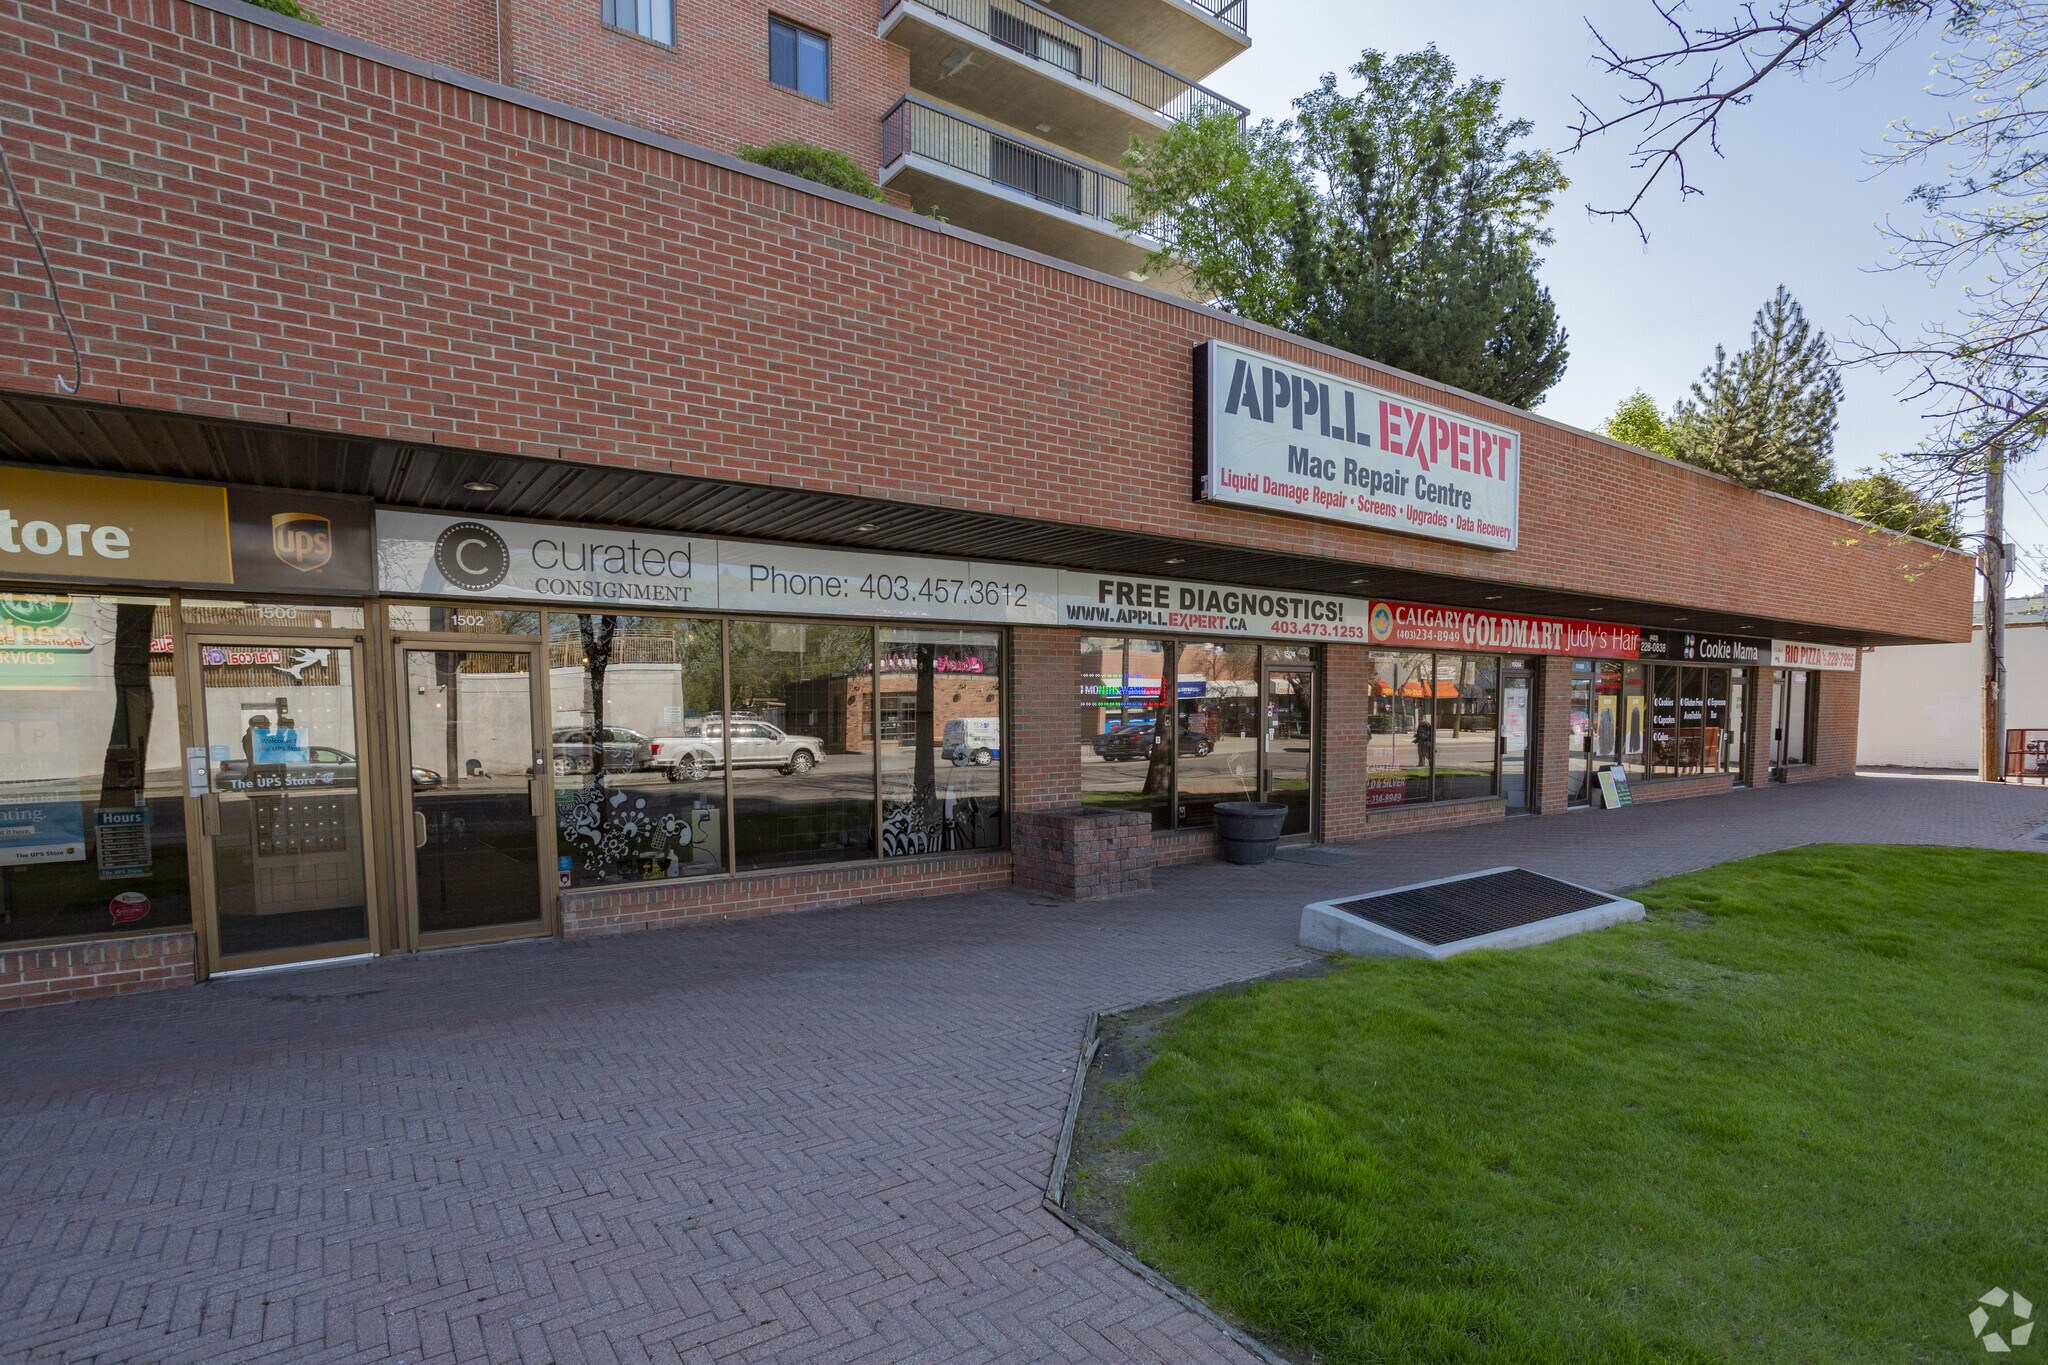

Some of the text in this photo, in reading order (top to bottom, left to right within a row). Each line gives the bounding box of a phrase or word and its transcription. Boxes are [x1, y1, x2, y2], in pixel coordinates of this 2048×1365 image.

[1379, 400, 1512, 482] EXPERT
[1288, 445, 1472, 510] Mac Repair Centre
[1221, 467, 1512, 542] Liquid Damage Repair Screens Upgrades Data Recovery
[277, 526, 328, 562] ups
[531, 538, 692, 579] curated
[535, 577, 692, 602] CONSIGNMENT
[749, 564, 1028, 607] Phone: 403.457.3612
[1098, 579, 1344, 623] FREE DIAGNOSTICS!
[256, 605, 297, 619] 1500
[450, 614, 485, 628] 1502
[1395, 606, 1461, 629] CALGARY
[1270, 621, 1364, 639] 403.473.1253
[1396, 628, 1460, 643] (403)234-8949
[1462, 612, 1638, 652] GOLDMART Judy's Hair
[1700, 639, 1731, 660] Cookie
[1733, 641, 1759, 661] Mama
[1785, 644, 1799, 663] RIO
[1801, 646, 1821, 666] PIZZA
[1659, 698, 1673, 706] Cookies
[1711, 698, 1726, 708] Espresso
[1658, 715, 1676, 726] Cupcakes
[1684, 711, 1702, 719] Available
[1658, 732, 1668, 740] Cakes
[230, 779, 253, 789] The
[257, 777, 282, 788] UPS
[285, 776, 316, 786] Store
[1382, 778, 1406, 788] SILVER
[103, 812, 142, 824] Hours
